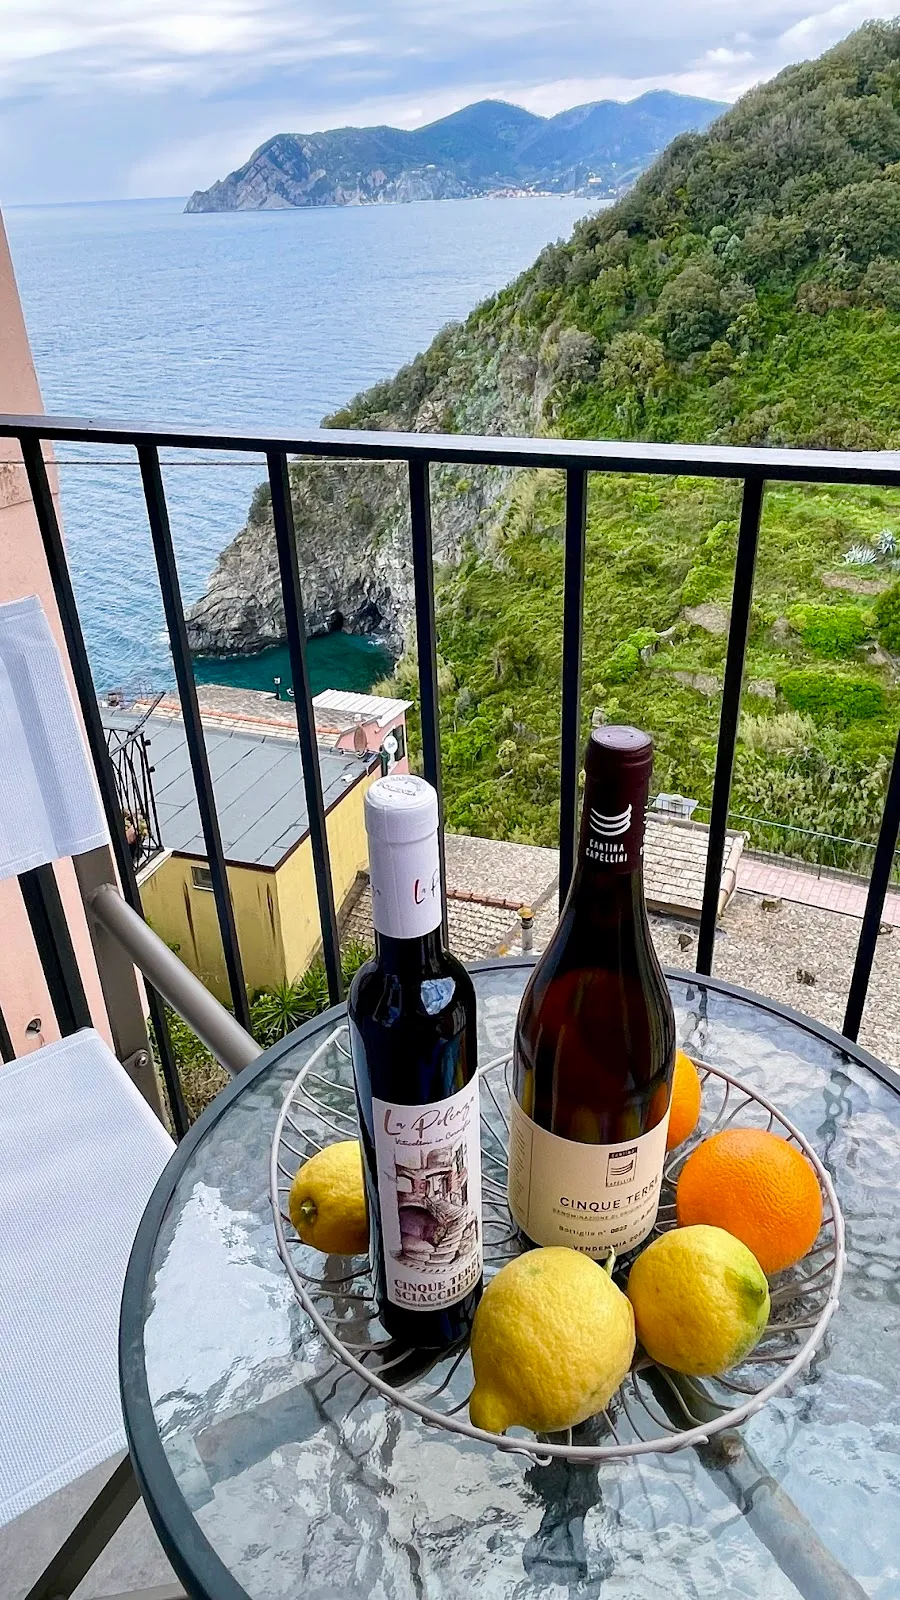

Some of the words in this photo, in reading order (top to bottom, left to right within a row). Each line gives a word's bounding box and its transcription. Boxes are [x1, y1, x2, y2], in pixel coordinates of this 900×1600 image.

[590, 839, 624, 852] CANTINA
[586, 848, 627, 863] CAPELLINI
[384, 1109, 406, 1136] La
[560, 1197, 620, 1212] CINQUE
[626, 1173, 659, 1204] TERRE
[559, 1225, 595, 1237] Bottiglia
[573, 1240, 627, 1252] VENDEMMIA
[394, 1279, 446, 1293] CINQUE
